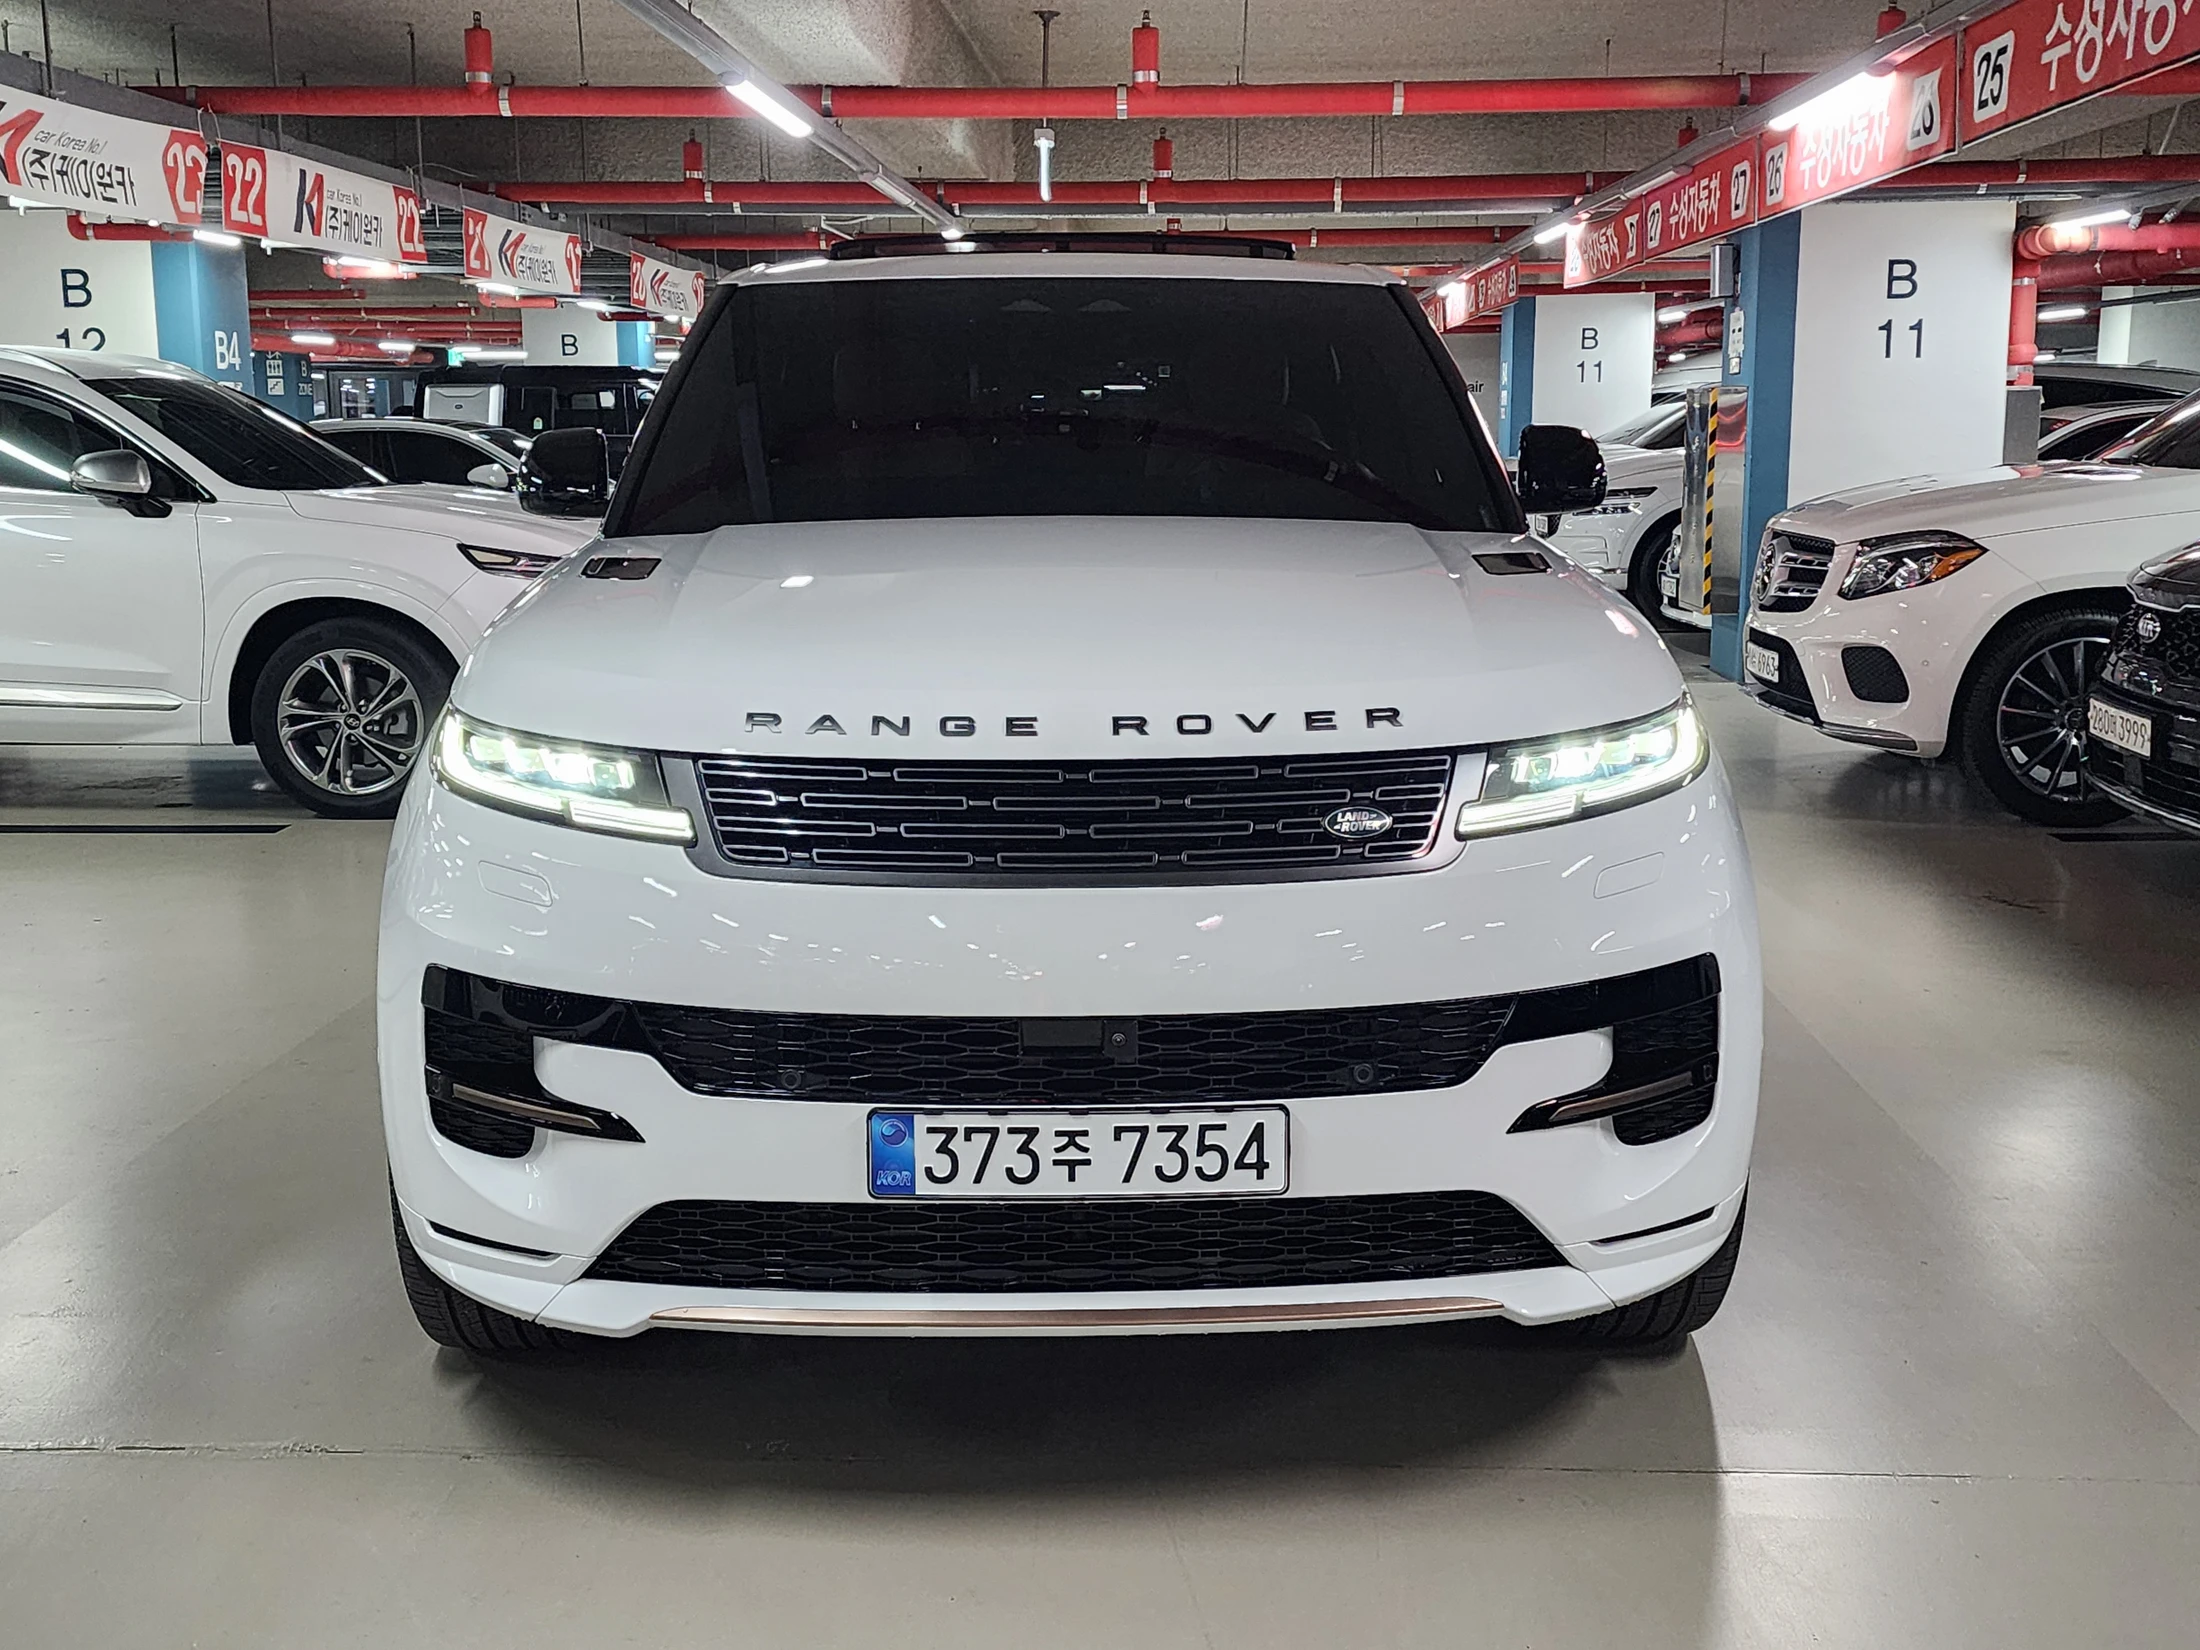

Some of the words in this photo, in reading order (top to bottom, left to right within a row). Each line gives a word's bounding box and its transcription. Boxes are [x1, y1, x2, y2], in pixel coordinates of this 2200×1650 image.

[2041, 0, 2195, 91] 수성자동
[1977, 45, 2009, 111] 25
[1911, 80, 1937, 137] 26
[34, 128, 56, 143] car
[56, 131, 84, 150] Korea
[22, 146, 138, 207] (주)케이원카
[166, 142, 208, 214] 23
[226, 152, 263, 226] 22
[1733, 168, 1748, 212] 27
[1768, 151, 1784, 197] 26
[325, 205, 383, 248] (주)케이원카
[398, 195, 425, 252] 22
[1649, 207, 1660, 242] 27
[1669, 171, 1722, 241] 수성자동차
[61, 269, 92, 308] B
[1886, 258, 1918, 299] B
[214, 330, 242, 371] B4
[561, 334, 579, 356] B
[1581, 327, 1599, 350] B
[1878, 318, 1923, 359] 11
[1576, 360, 1603, 383] 11
[744, 711, 1039, 737] RANGE
[1111, 707, 1404, 736] ROVER
[2118, 715, 2147, 749] 3999
[1336, 811, 1370, 822] LAND
[1340, 820, 1381, 833] ROVER
[924, 1125, 1092, 1185] 373주
[1113, 1121, 1270, 1184] 7354
[876, 1169, 912, 1188] KOR
